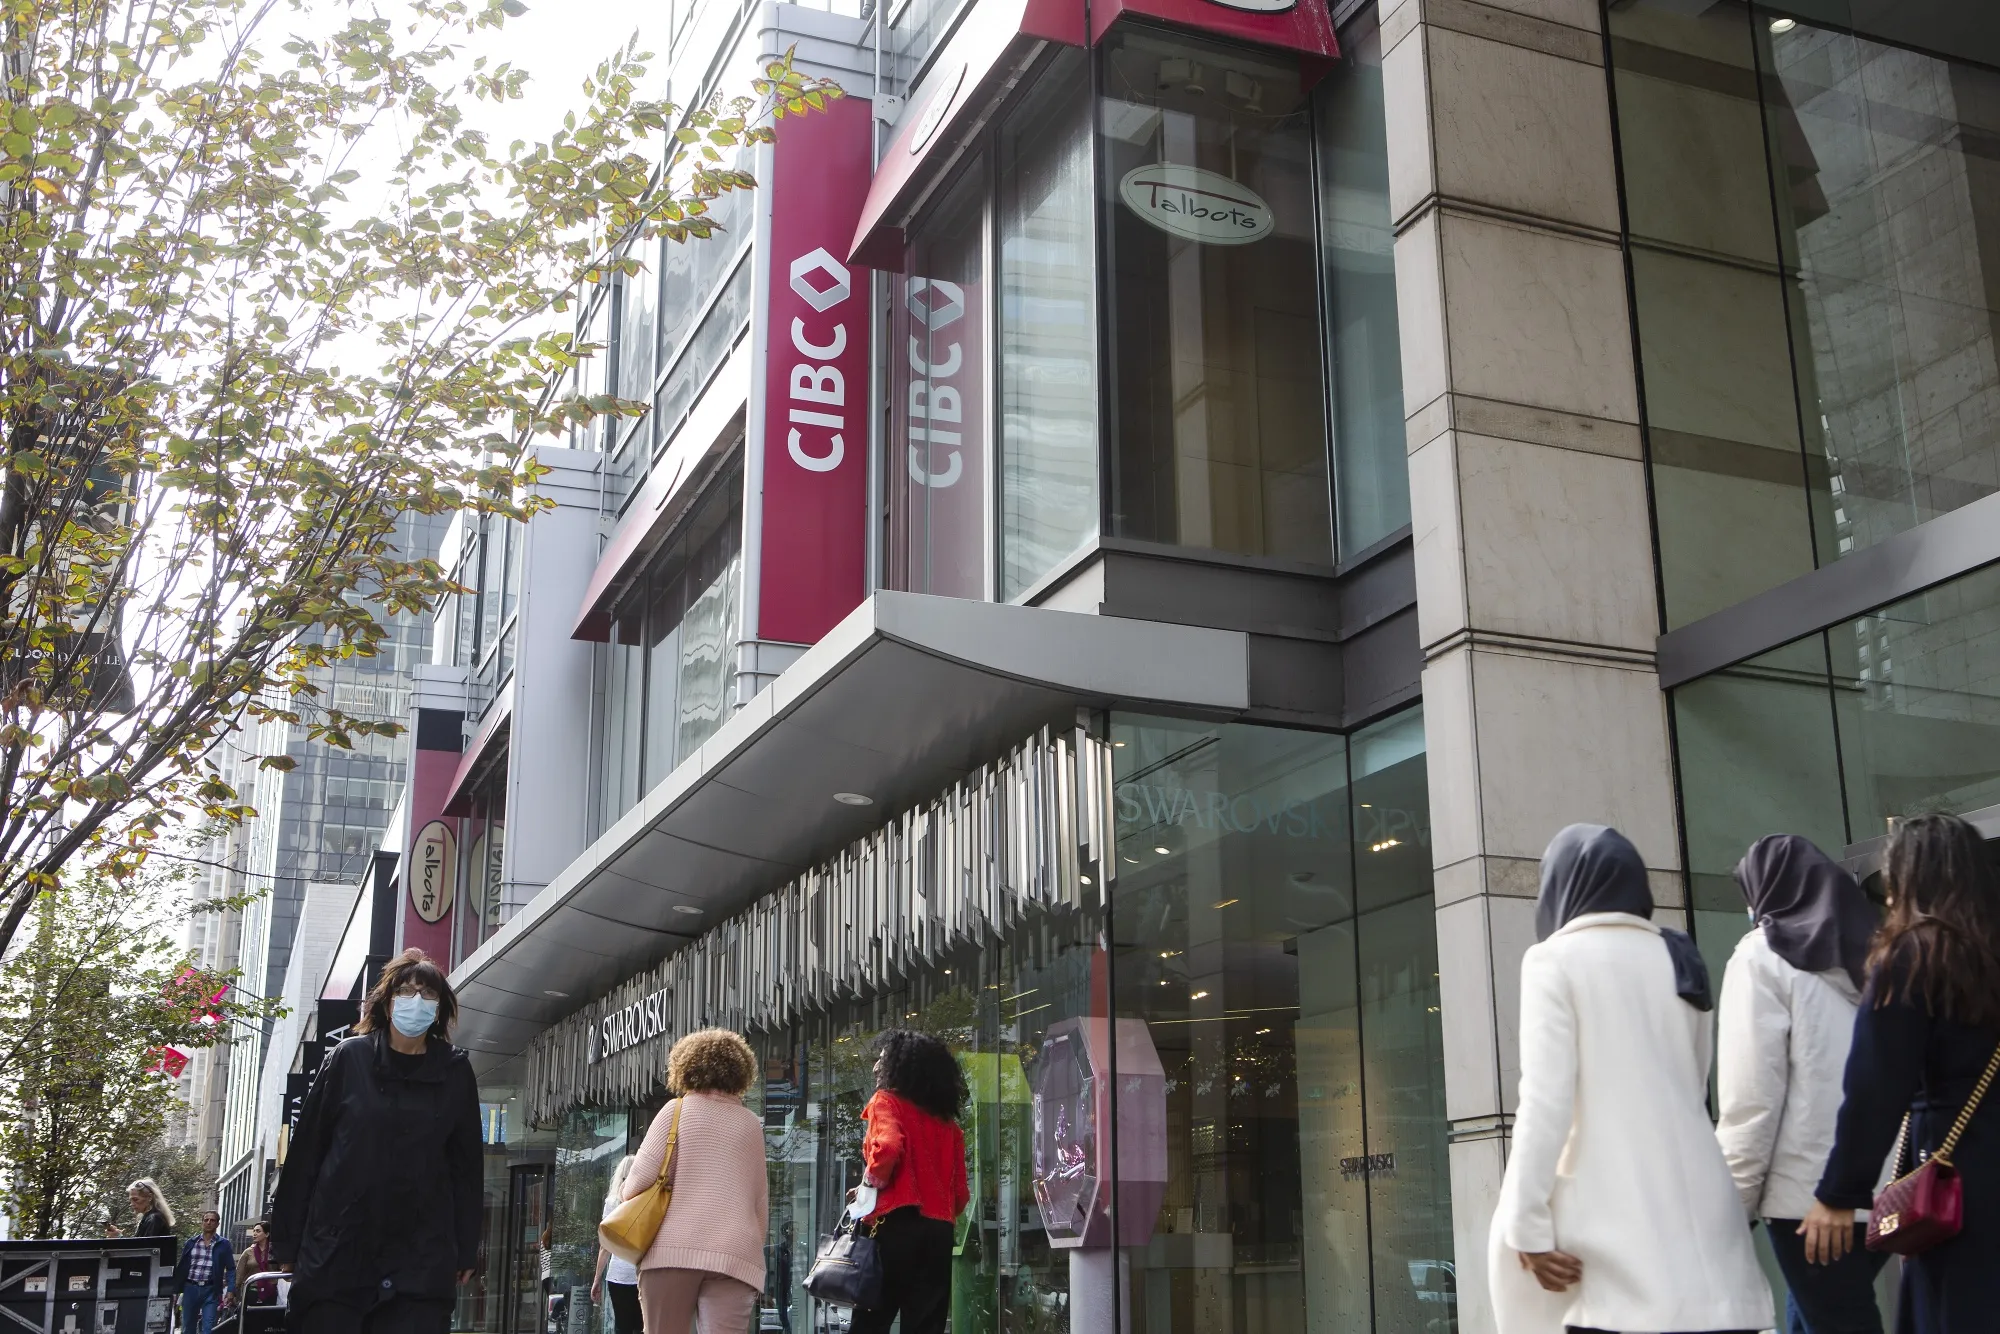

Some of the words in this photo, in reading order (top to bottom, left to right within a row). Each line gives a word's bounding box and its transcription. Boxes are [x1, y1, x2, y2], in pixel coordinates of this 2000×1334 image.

[1133, 180, 1261, 233] Talbots
[788, 315, 847, 472] CIBC
[422, 827, 446, 917] Talbots
[602, 987, 668, 1058] SWAROVSKI
